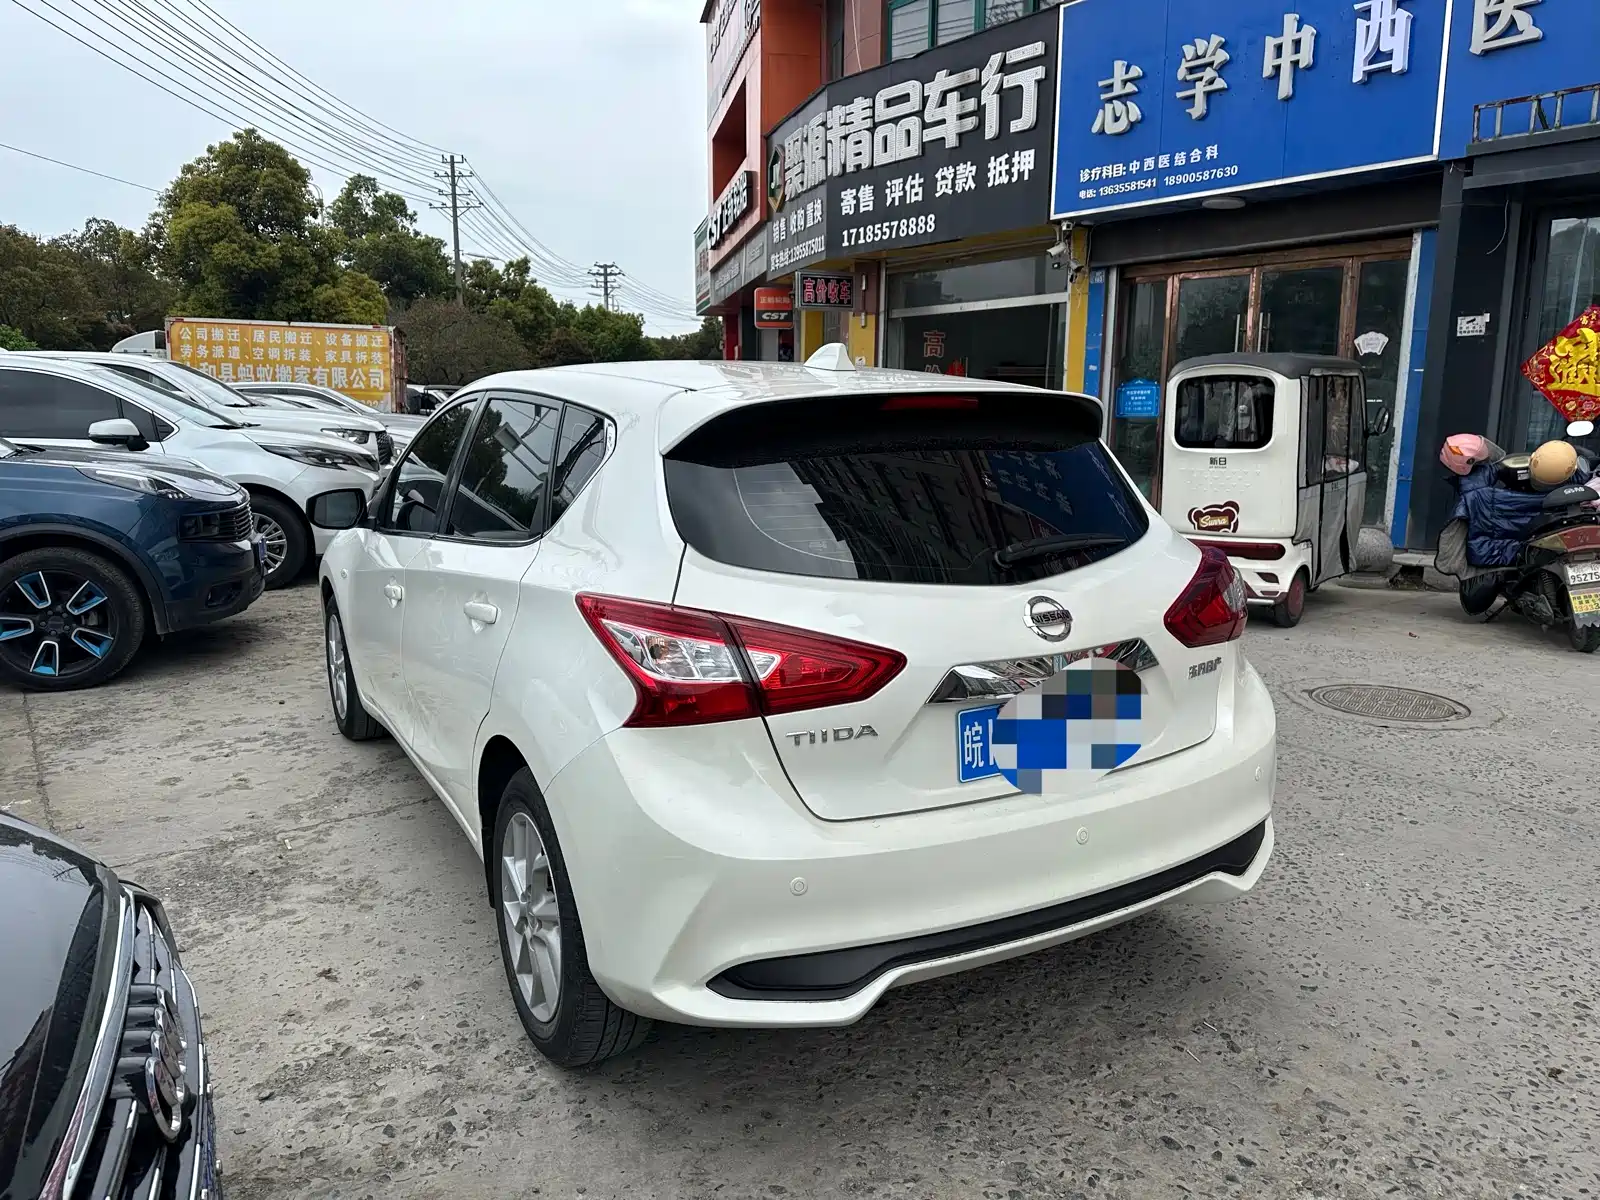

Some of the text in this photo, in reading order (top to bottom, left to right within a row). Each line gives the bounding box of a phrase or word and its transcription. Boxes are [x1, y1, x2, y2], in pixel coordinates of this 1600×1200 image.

[790, 207, 805, 235] 收购
[806, 198, 822, 228] 置换
[841, 184, 875, 216] 寄售
[885, 173, 924, 207] 评估
[935, 161, 977, 198] 贷款
[987, 149, 1035, 188] 抵押
[1099, 177, 1157, 197] 13635581541
[1164, 165, 1239, 186] 18900587630
[842, 213, 936, 247] 17185578888
[803, 278, 851, 305] 高价收车
[761, 312, 788, 320] CST
[1209, 456, 1227, 466] 新日
[1031, 608, 1070, 625] NISSAN
[785, 723, 879, 747] TIIDA
